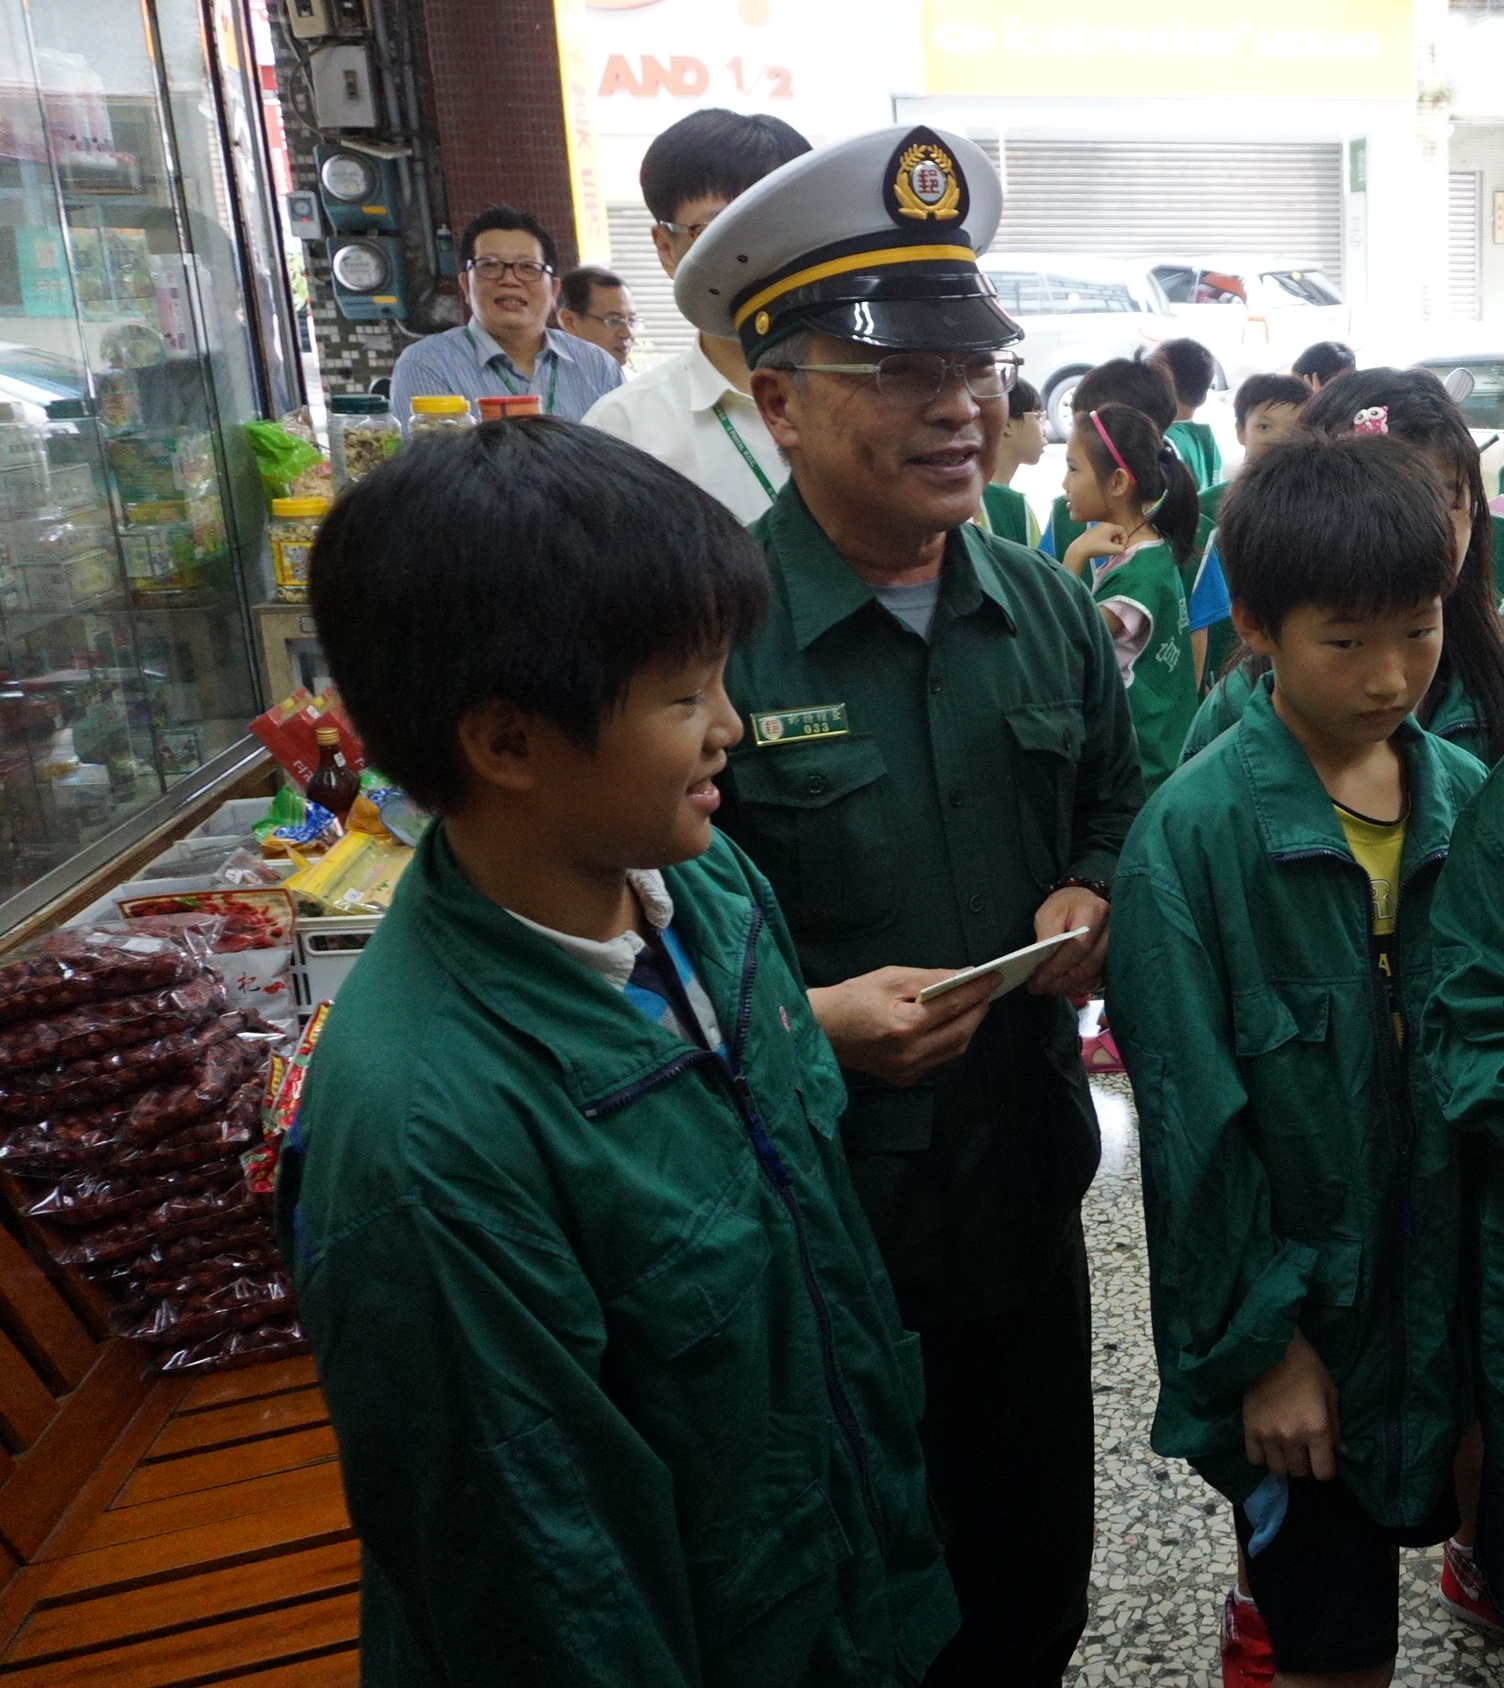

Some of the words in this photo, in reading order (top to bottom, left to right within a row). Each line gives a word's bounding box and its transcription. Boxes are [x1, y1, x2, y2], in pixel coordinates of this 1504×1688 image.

[1258, 31, 1380, 58] MERINO
[597, 54, 710, 98] AND
[803, 722, 829, 735] 033
